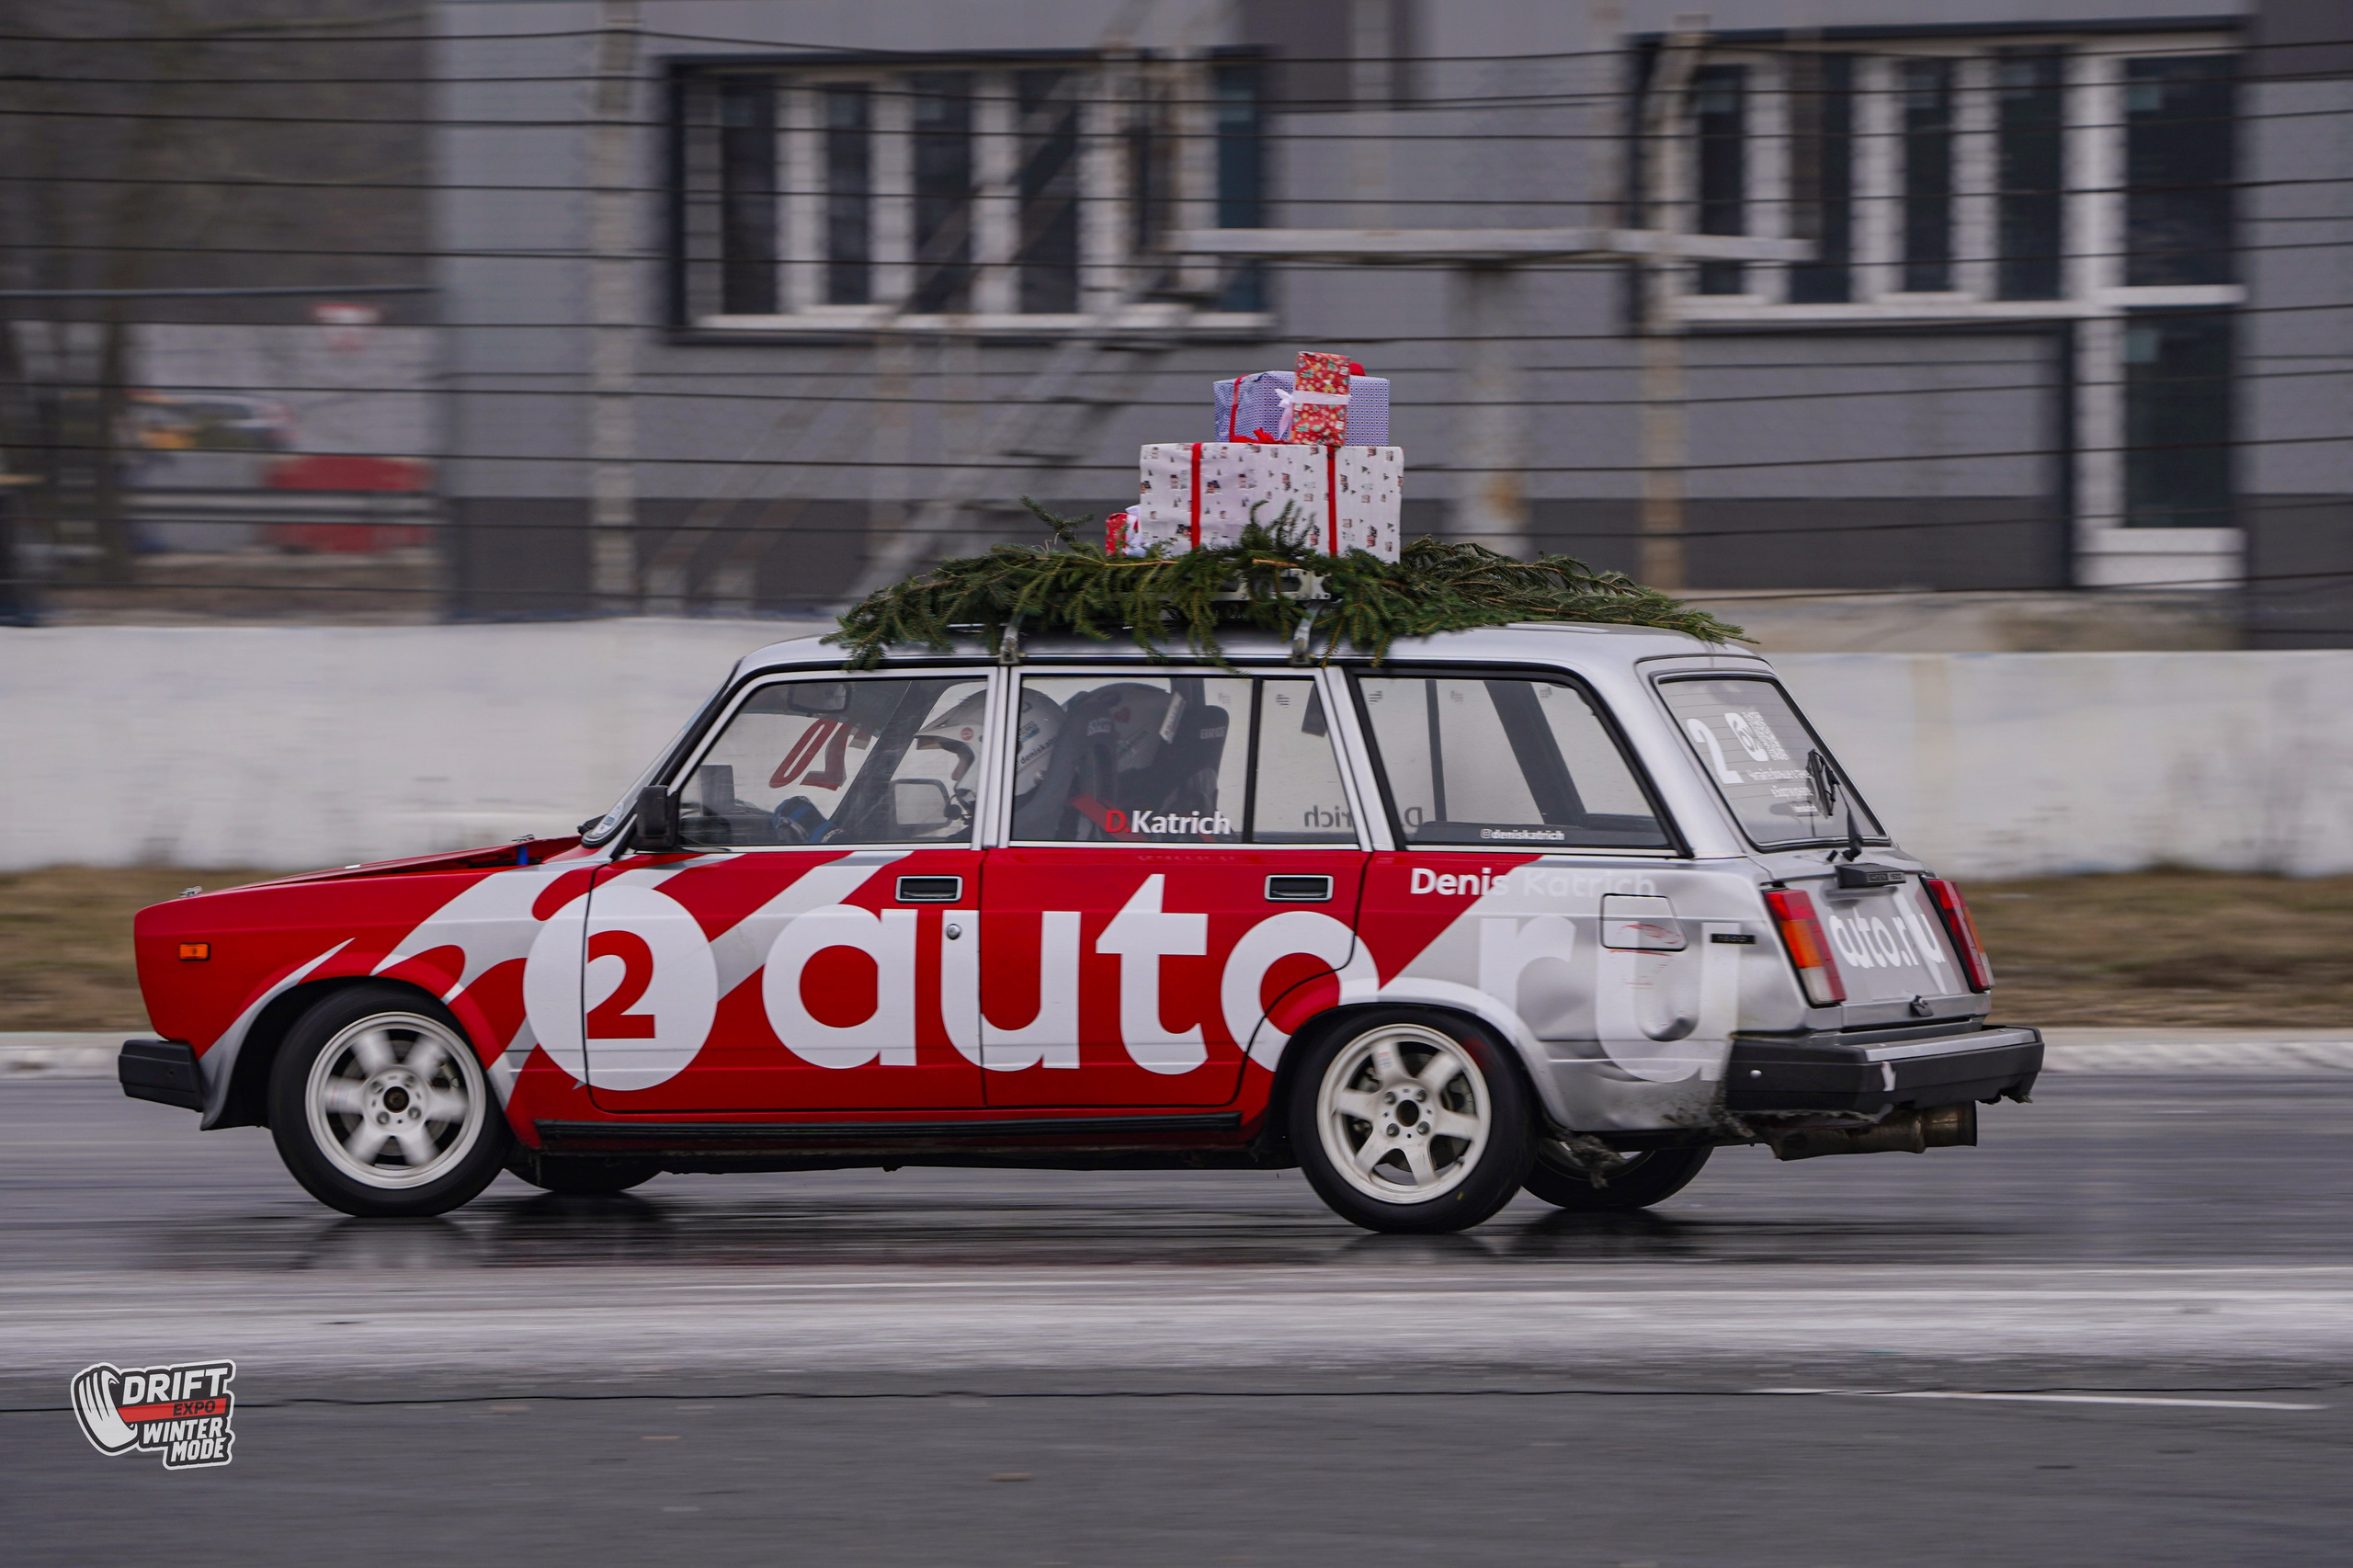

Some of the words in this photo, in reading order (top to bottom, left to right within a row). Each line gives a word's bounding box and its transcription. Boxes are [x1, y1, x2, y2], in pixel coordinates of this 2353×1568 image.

[1686, 718, 1745, 784] 2
[1104, 809, 1232, 835] D.Katrich
[1410, 868, 1510, 896] Denis
[1523, 870, 1655, 897] Katrich
[1828, 906, 1946, 969] auto.ru
[585, 929, 655, 1040] 2
